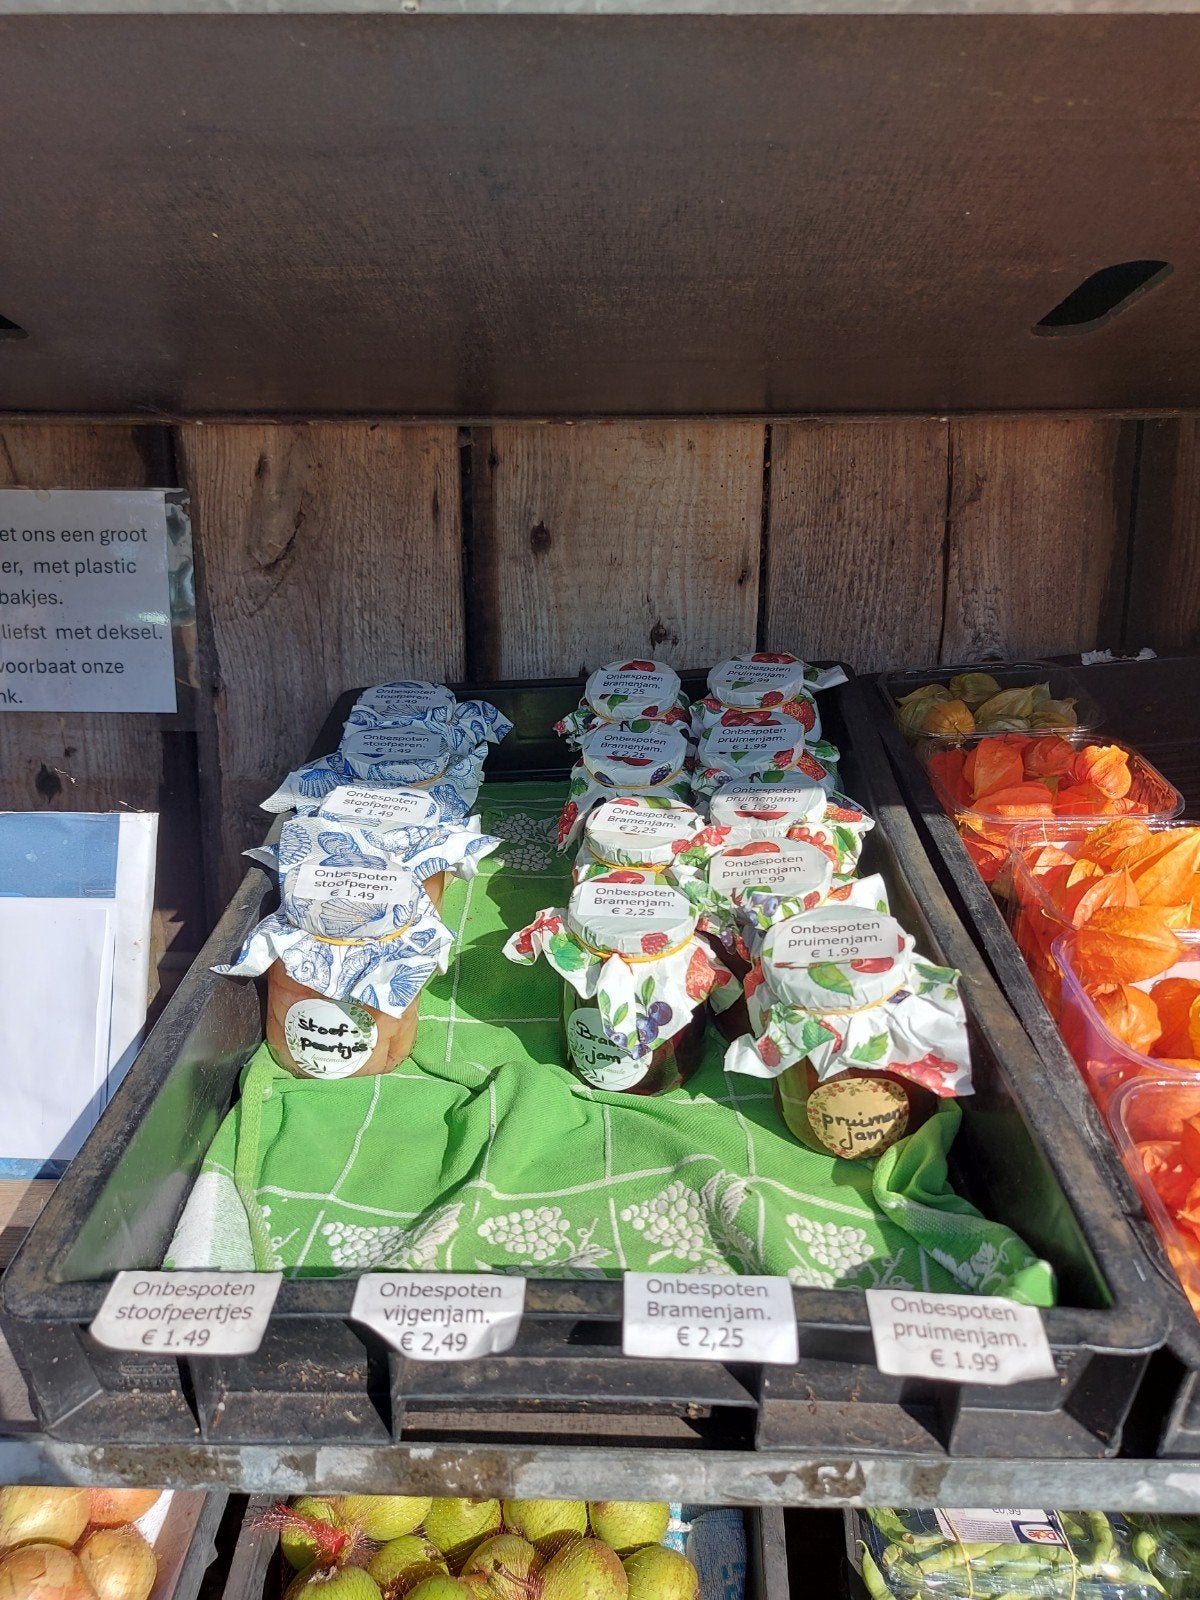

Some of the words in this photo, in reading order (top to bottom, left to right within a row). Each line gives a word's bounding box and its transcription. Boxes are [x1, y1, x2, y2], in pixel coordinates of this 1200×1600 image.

[22, 529, 55, 542] ons
[61, 529, 94, 542] een
[100, 527, 148, 546] groot
[34, 559, 69, 574] met
[75, 558, 137, 577] plastic
[2, 624, 47, 640] liefst
[56, 625, 91, 640] met
[97, 624, 163, 640] deksel.
[82, 662, 124, 674] onze
[734, 664, 791, 672] Onbespoten
[606, 673, 663, 682] Onbespoten
[722, 728, 787, 736] Onbespoten
[604, 734, 667, 746] Onbespoten
[717, 735, 787, 744] pruimenjam.
[600, 742, 663, 753] Bramenjam.
[346, 790, 418, 806] Onbespoten
[732, 787, 801, 795] Onbespoten
[342, 798, 411, 813] stoofperen.
[726, 796, 799, 804] pruimenjam.
[752, 803, 778, 811] 1.99
[368, 808, 394, 818] 1.49
[612, 807, 682, 821] Onbespoten
[607, 815, 677, 829] Bramenjam.
[630, 825, 658, 834] 2,25
[724, 855, 804, 869] Onbespoten
[314, 869, 397, 882] Onbespoten
[722, 865, 806, 879] pruimenjam.
[314, 878, 393, 892] stoofperen.
[742, 878, 752, 886] €
[756, 875, 786, 885] 1.99
[330, 889, 340, 897] €
[345, 890, 376, 900] 1.49
[595, 887, 676, 900] Onbespoten
[594, 897, 675, 908] Bramenjam.
[611, 907, 620, 915] €
[624, 908, 656, 917] 2,25
[790, 921, 880, 934] Onbespoten
[788, 934, 884, 948] pruimenjam.
[810, 950, 821, 958] €
[827, 947, 859, 958] 1.99
[585, 1046, 621, 1065] jam
[839, 1126, 885, 1150] jam
[133, 1281, 256, 1301] Onbespoten
[380, 1282, 502, 1301] Onbespoten
[646, 1278, 769, 1298] Onbespoten
[115, 1303, 254, 1324] stoofpeertjes
[383, 1305, 491, 1327] vijgenjam.
[647, 1301, 772, 1322] Bramenjam.
[891, 1296, 1017, 1322] Onbespoten
[141, 1328, 157, 1345] €
[163, 1329, 211, 1346] 1.49
[677, 1326, 690, 1346] €
[698, 1327, 744, 1351] 2,25
[893, 1321, 1028, 1348] pruimenjam.
[401, 1331, 414, 1351] €
[421, 1332, 467, 1355] 2,49
[930, 1349, 945, 1368] €
[953, 1351, 999, 1371] 1.99
